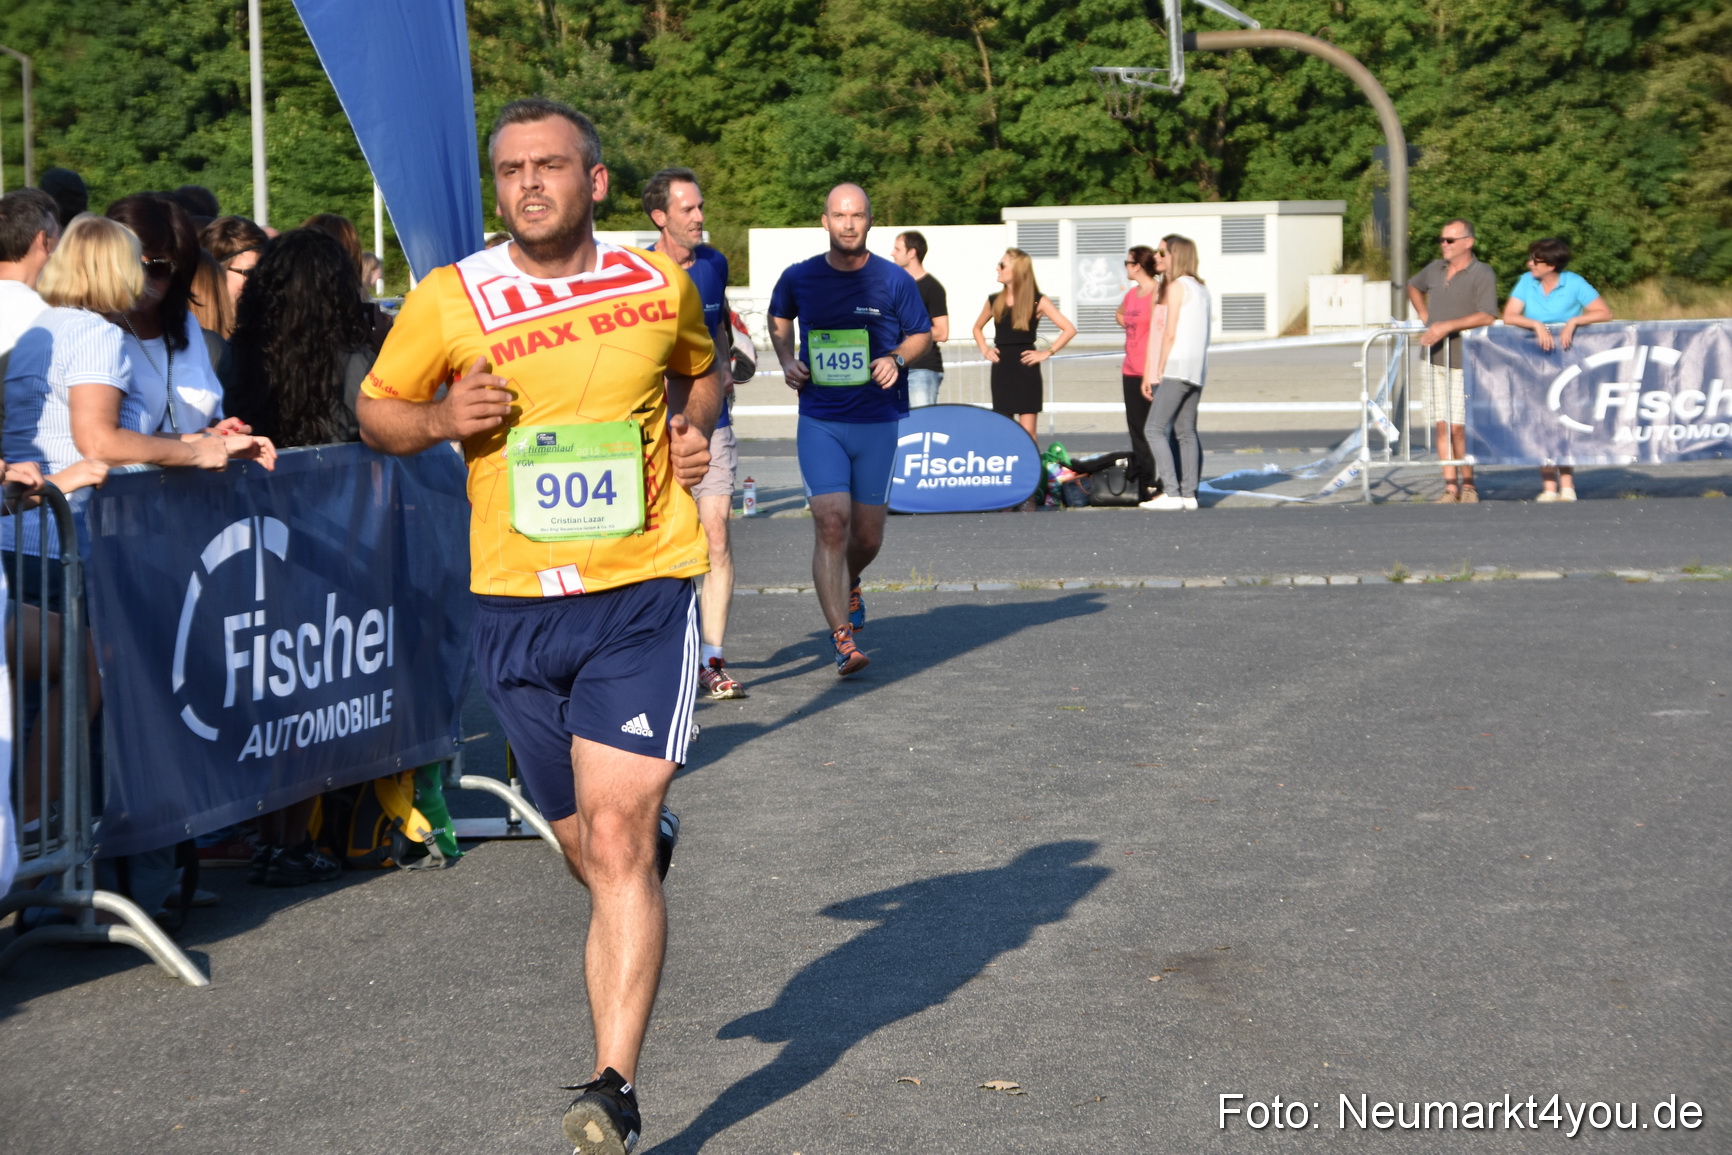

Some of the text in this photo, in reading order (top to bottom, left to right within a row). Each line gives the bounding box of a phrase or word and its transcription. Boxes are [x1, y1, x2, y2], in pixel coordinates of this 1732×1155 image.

[490, 300, 677, 366] MAX BÖGL
[816, 352, 864, 370] 1495
[1613, 422, 1732, 443] AUTOMO
[528, 443, 575, 453] firmenlauf
[904, 450, 1019, 477] Fischer
[536, 469, 617, 509] 904
[916, 475, 1012, 490] AUTOMOBILE
[551, 516, 582, 525] Cristian
[237, 688, 394, 762] AUTOMOBILE
[621, 724, 654, 737] adidas
